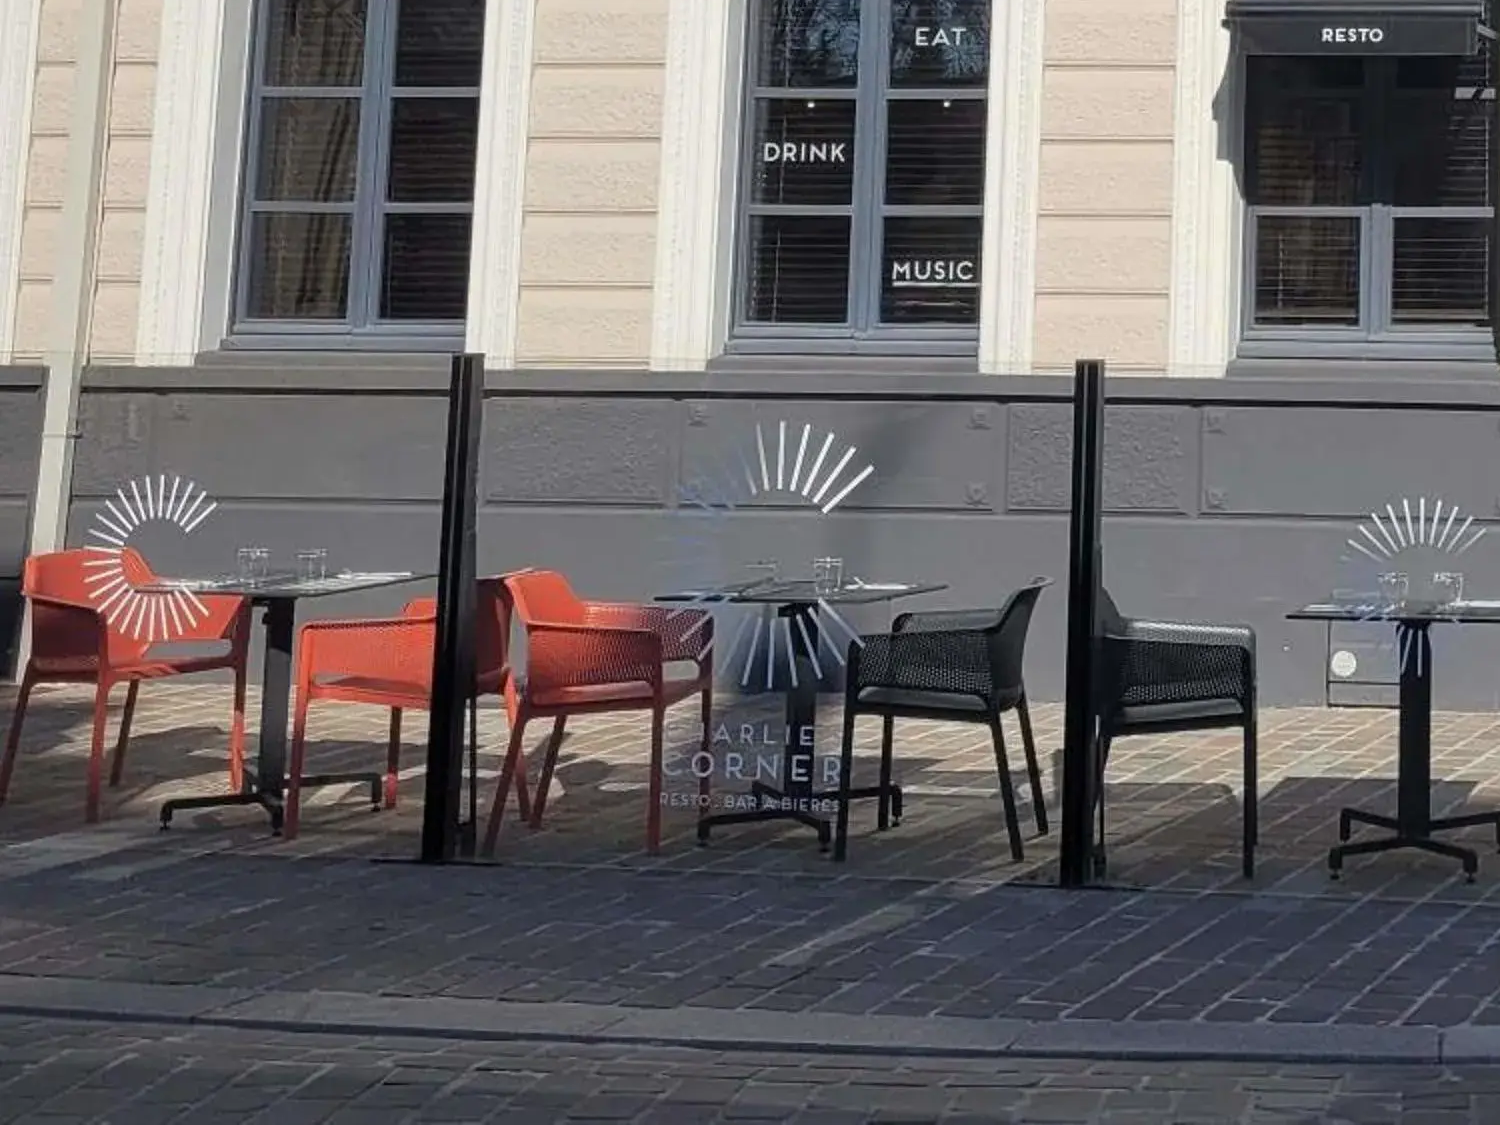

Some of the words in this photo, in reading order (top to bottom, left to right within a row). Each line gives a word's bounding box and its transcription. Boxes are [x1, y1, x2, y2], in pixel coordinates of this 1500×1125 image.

[914, 27, 967, 46] EAT
[1321, 27, 1384, 42] RESTO
[762, 142, 846, 163] DRINK
[891, 260, 974, 281] MUSIC
[662, 751, 841, 783] CORNER
